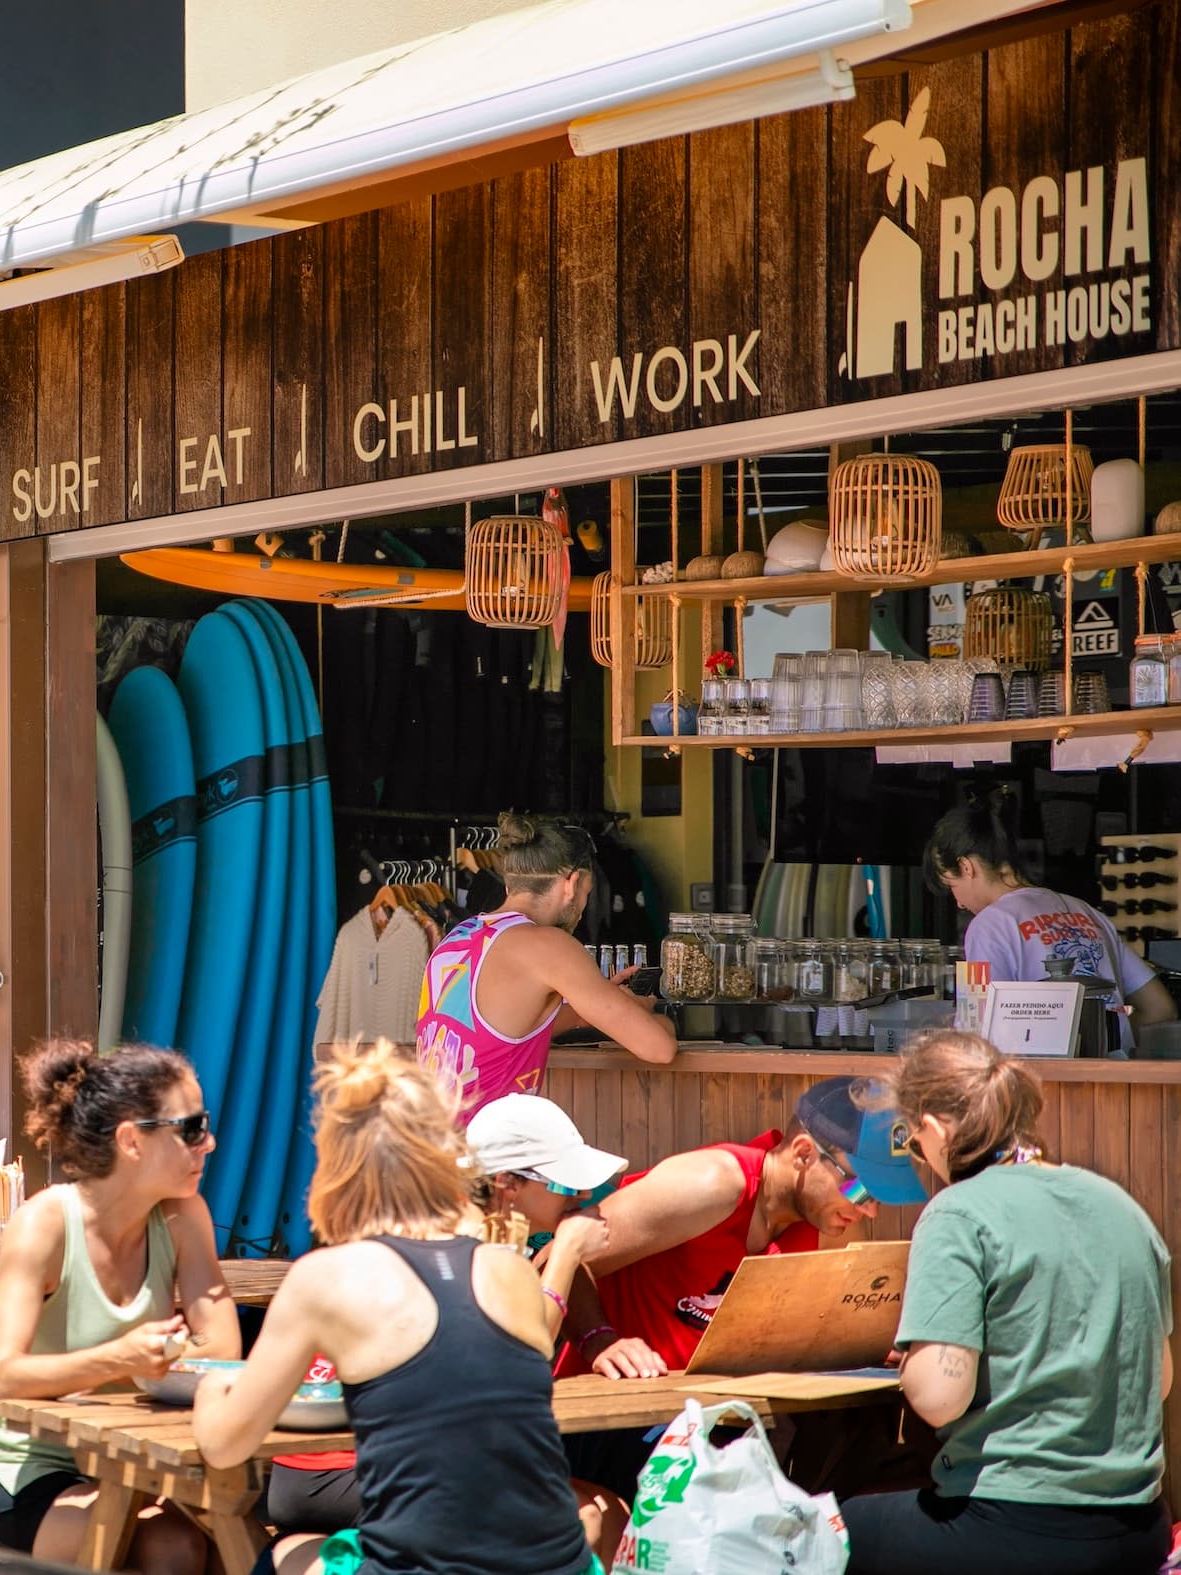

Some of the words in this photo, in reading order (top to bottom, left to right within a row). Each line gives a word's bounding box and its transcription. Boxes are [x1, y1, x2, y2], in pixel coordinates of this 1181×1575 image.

[939, 157, 1151, 299] ROCHA
[938, 295, 1037, 364] BEACH
[1045, 274, 1151, 347] HOUSE
[12, 456, 102, 523] SURF
[179, 427, 253, 495] EAT
[353, 386, 479, 464] CHILL
[590, 329, 762, 424] WORK
[1073, 632, 1117, 653] REEF
[1047, 1002, 1064, 1010] AQUI
[841, 1292, 901, 1304] ROCHA
